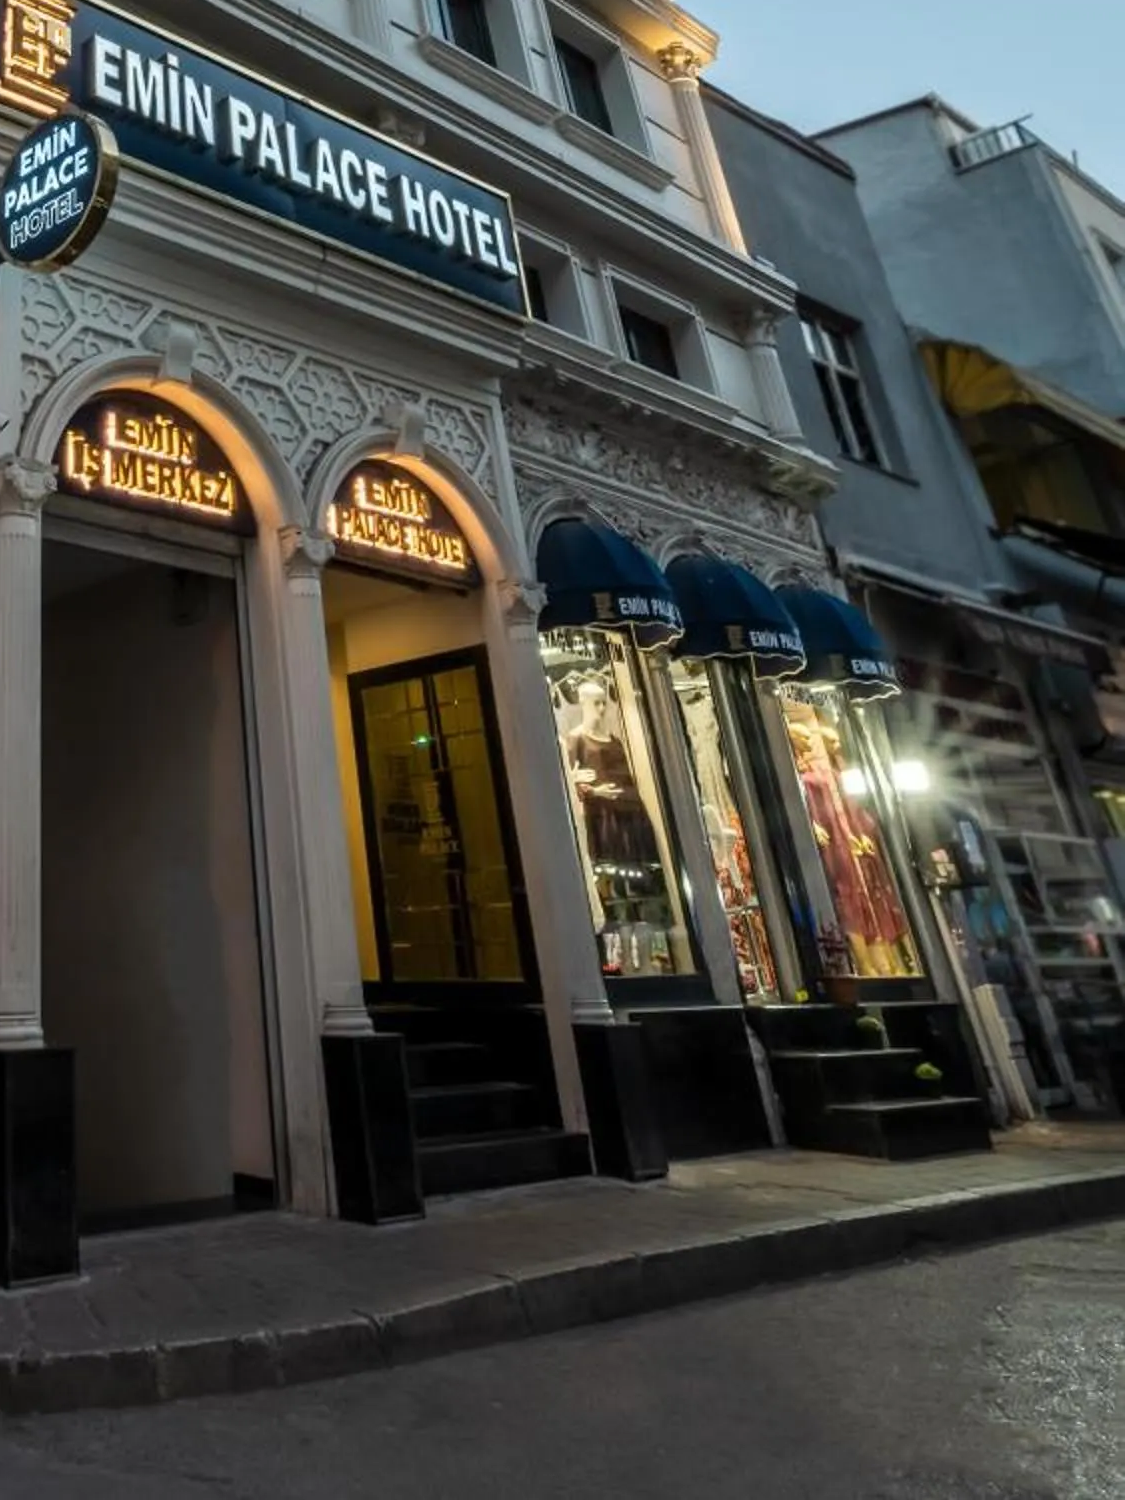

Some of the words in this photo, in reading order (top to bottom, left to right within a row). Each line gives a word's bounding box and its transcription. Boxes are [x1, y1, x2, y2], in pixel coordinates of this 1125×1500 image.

[19, 122, 76, 177] EMİN
[94, 33, 215, 146] EMİN
[229, 95, 393, 222] PALACE
[400, 174, 519, 276] HOTEL
[4, 147, 88, 218] PALACE
[10, 188, 83, 249] HOTEL
[106, 411, 196, 465] EMİN
[354, 476, 433, 522] EMİN
[326, 503, 411, 554] PALACE
[410, 522, 467, 569] HOTEL
